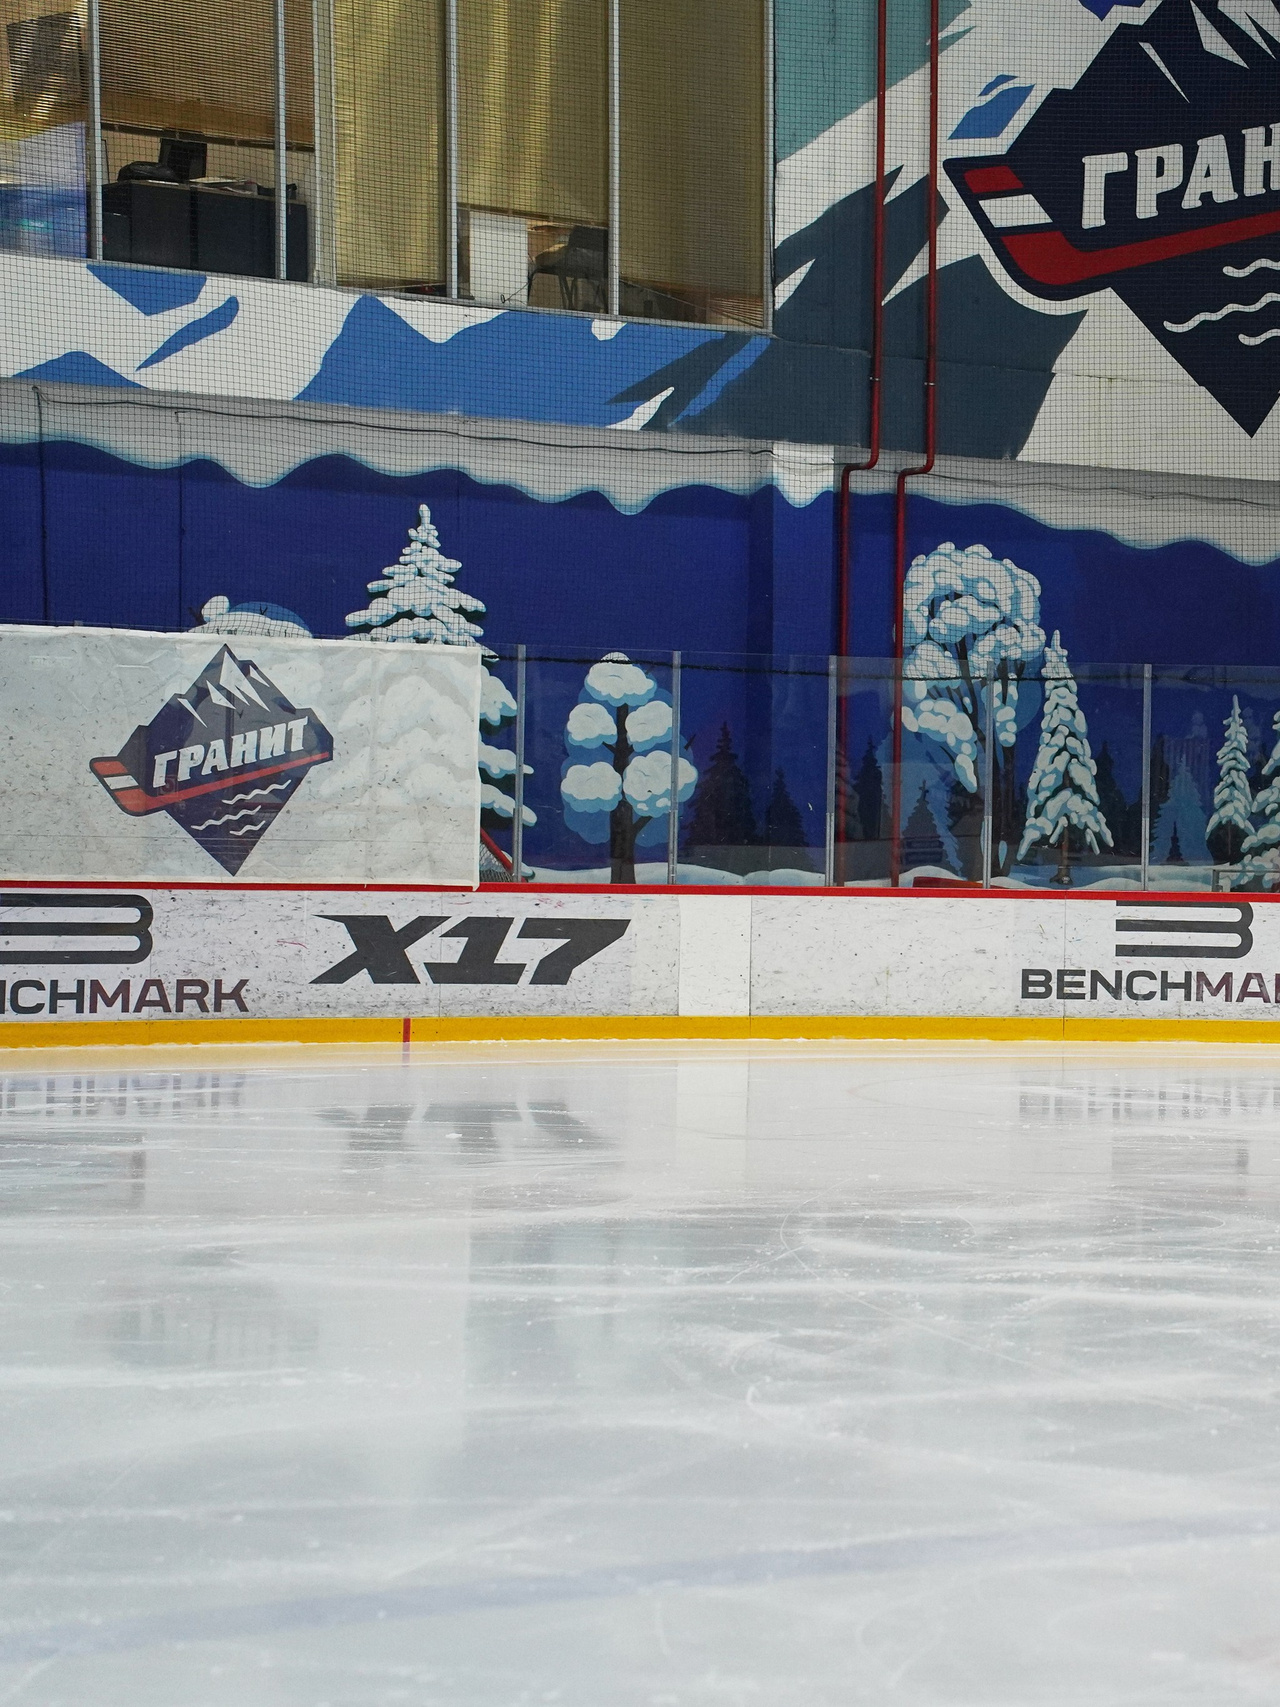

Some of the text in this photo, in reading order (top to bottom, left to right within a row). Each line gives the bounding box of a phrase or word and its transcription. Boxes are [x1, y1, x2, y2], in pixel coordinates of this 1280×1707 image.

[152, 716, 309, 788] ГРАНИТ
[308, 914, 631, 985] X17
[0, 978, 249, 1014] CHMARK
